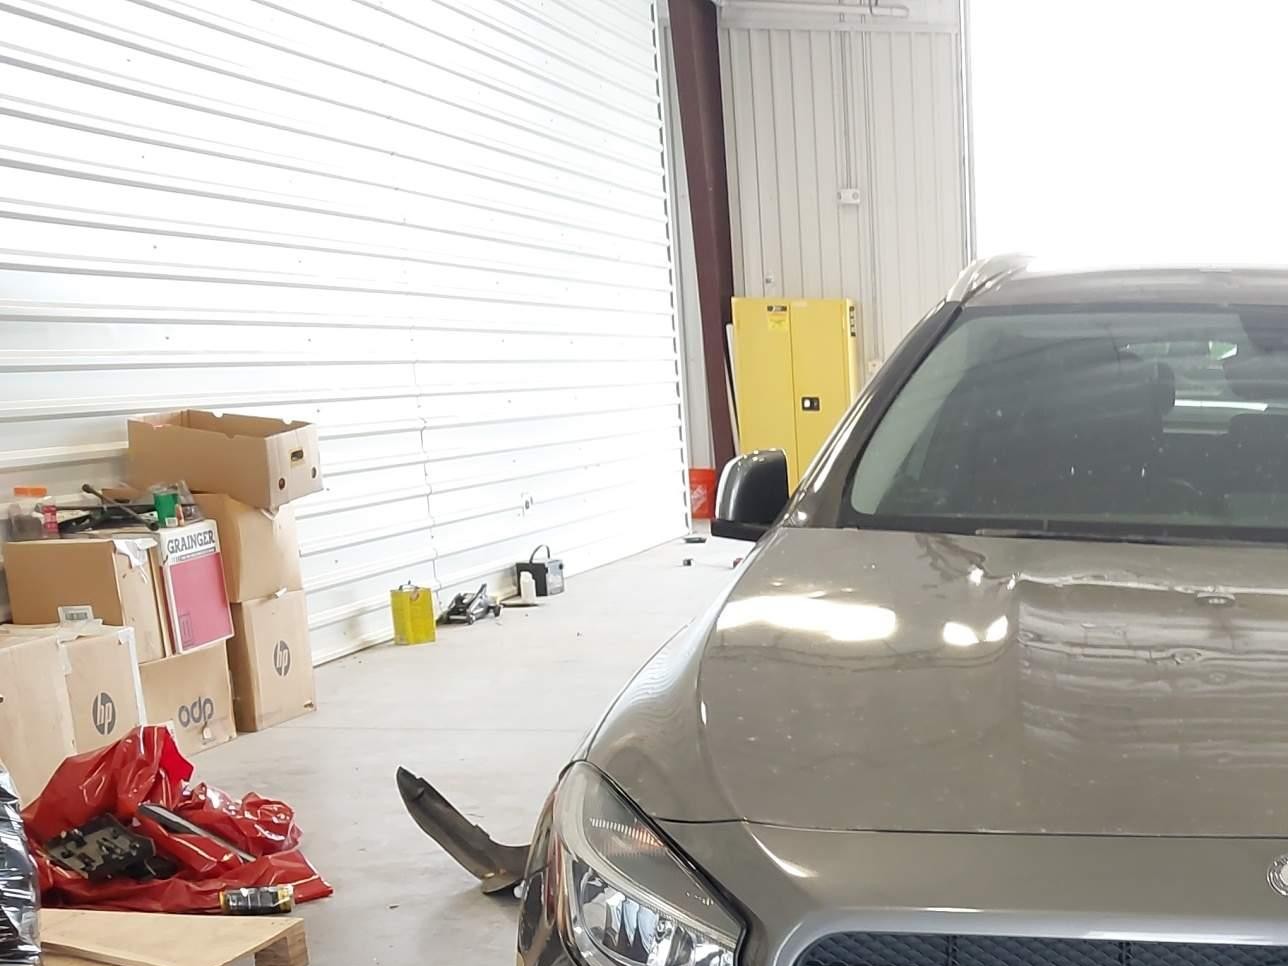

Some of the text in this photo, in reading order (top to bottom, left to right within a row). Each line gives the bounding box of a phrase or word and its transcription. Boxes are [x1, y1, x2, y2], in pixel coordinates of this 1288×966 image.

[167, 530, 215, 553] GRAINGER
[274, 640, 290, 676] hp
[93, 692, 115, 735] hp
[178, 696, 213, 728] odp
